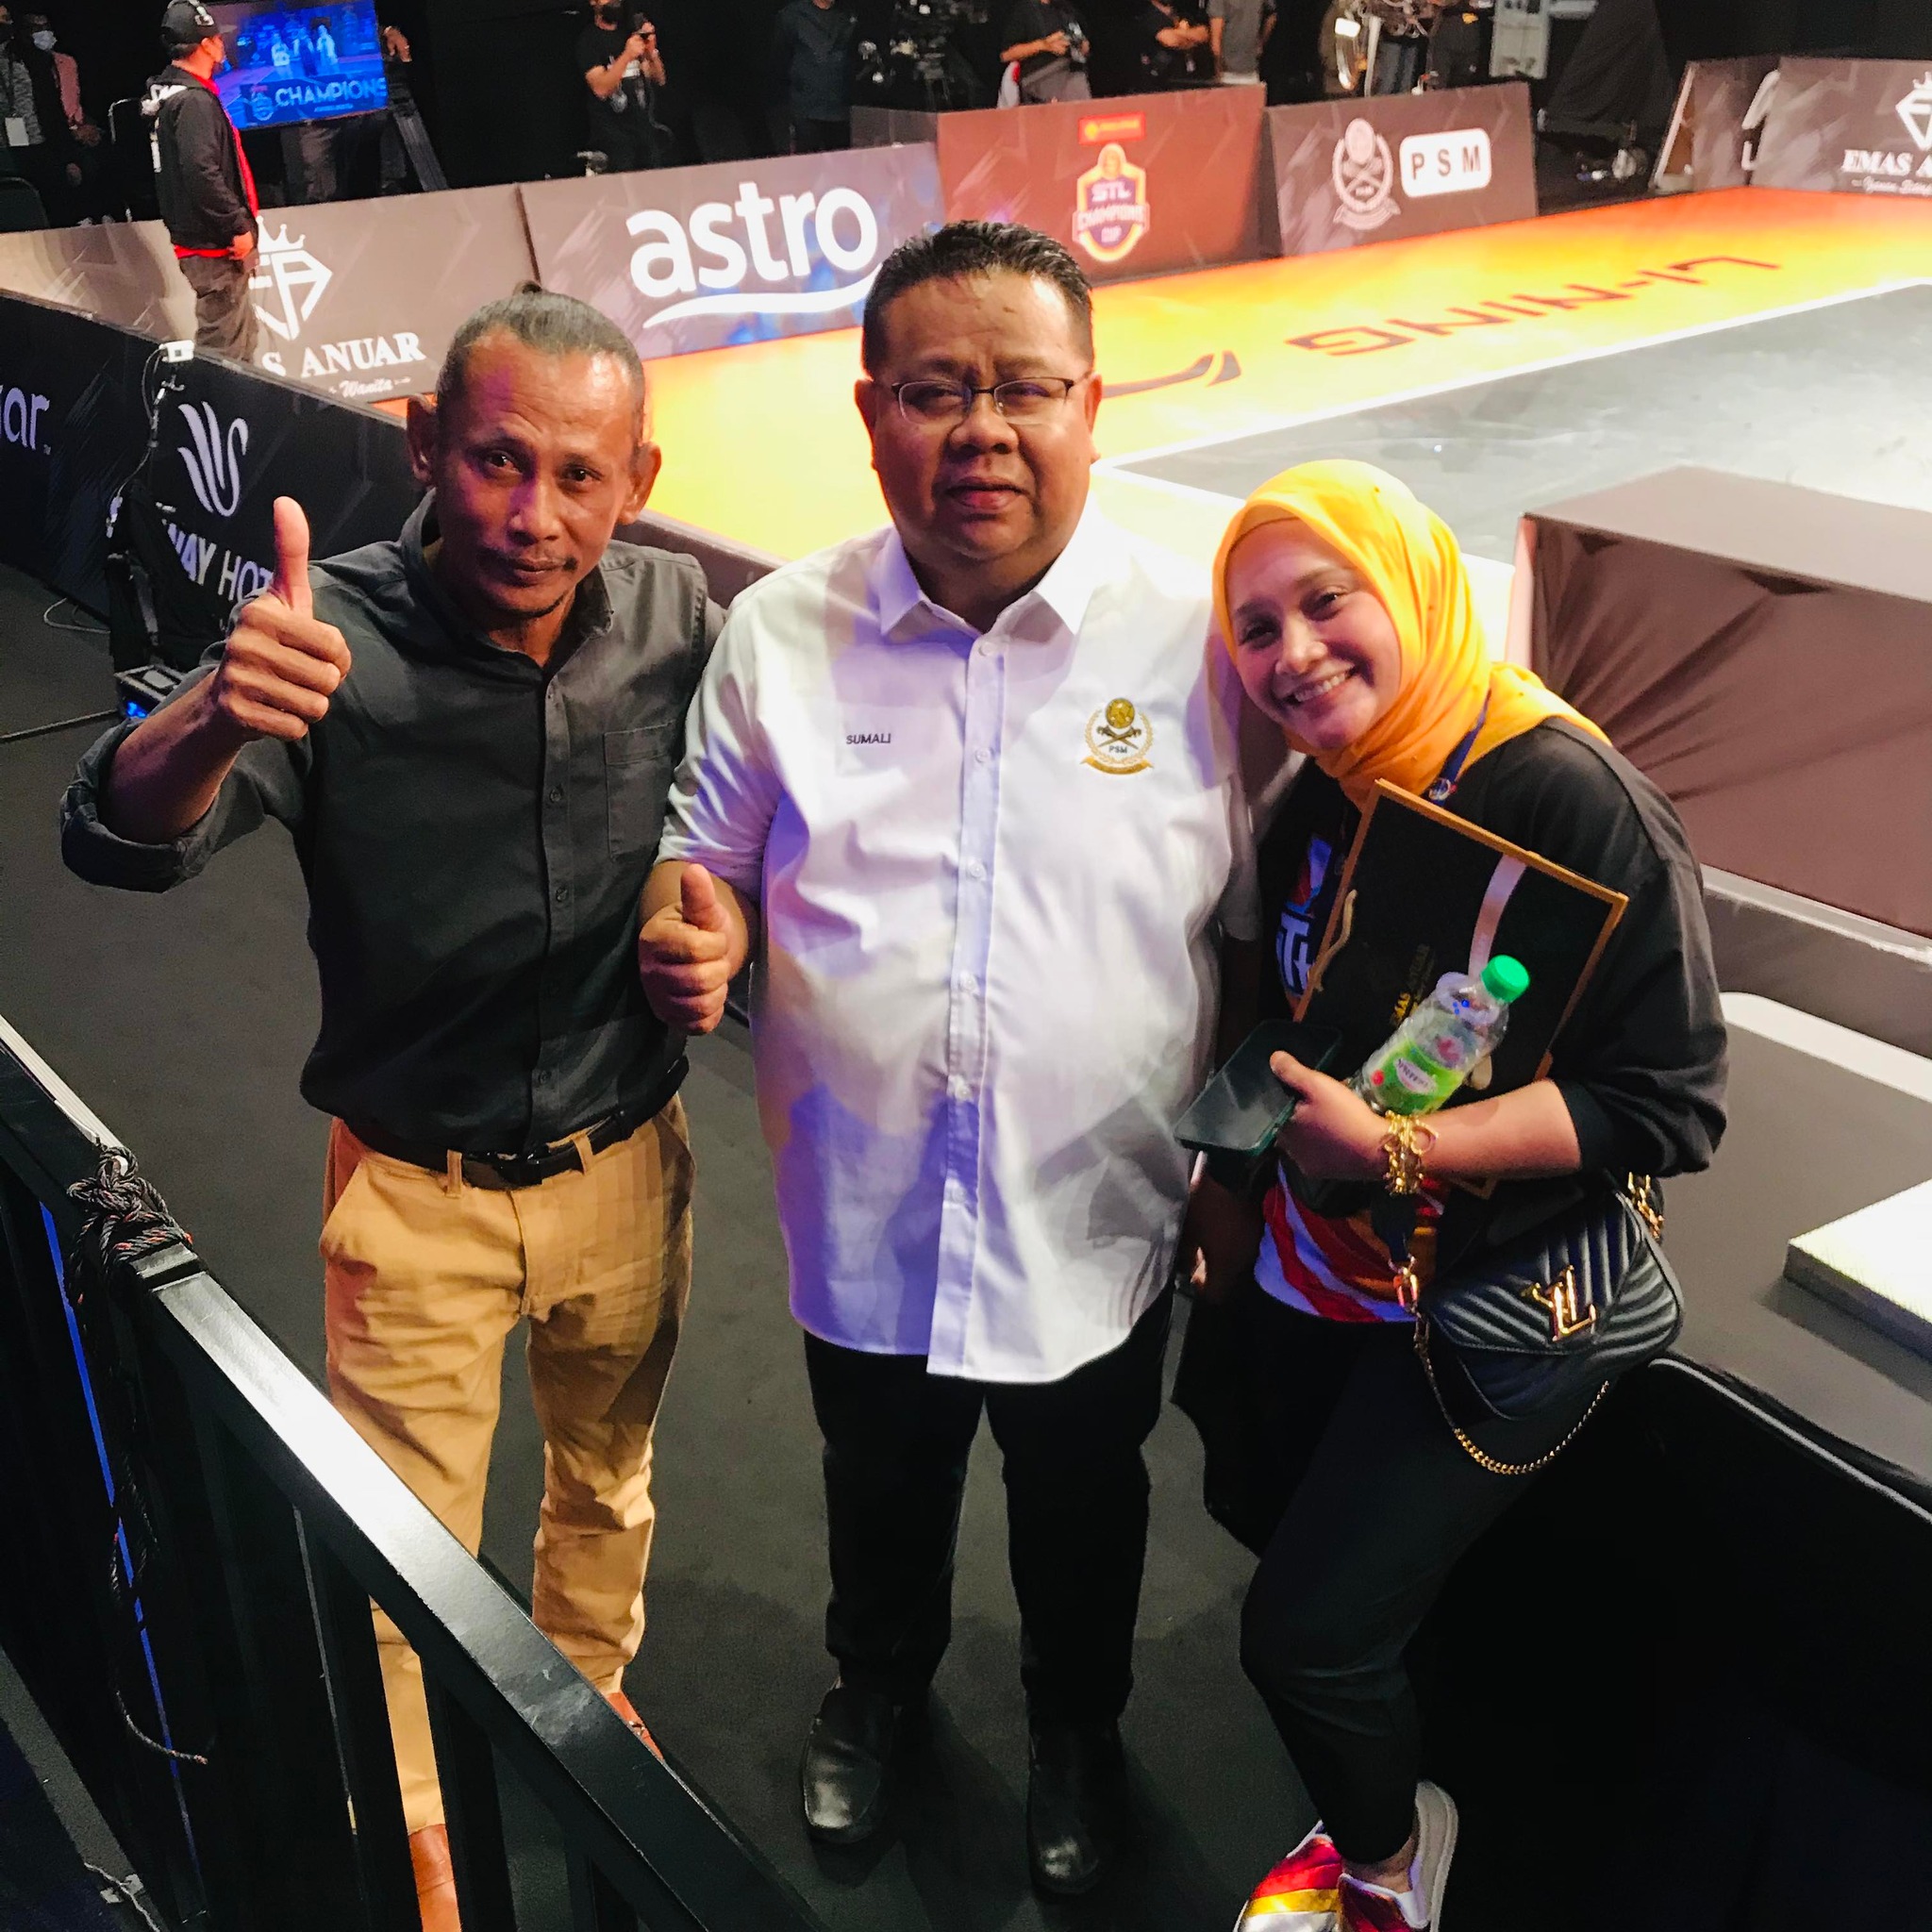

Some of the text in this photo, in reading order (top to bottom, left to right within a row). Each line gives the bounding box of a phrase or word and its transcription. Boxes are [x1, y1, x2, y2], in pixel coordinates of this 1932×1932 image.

[1840, 149, 1913, 176] EMAS
[1091, 180, 1131, 203] STL
[625, 181, 877, 297] astro
[1284, 255, 1780, 356] LI-NING
[301, 332, 426, 377] ANUAR
[846, 733, 891, 744] SUMALI
[1108, 745, 1127, 754] PSM
